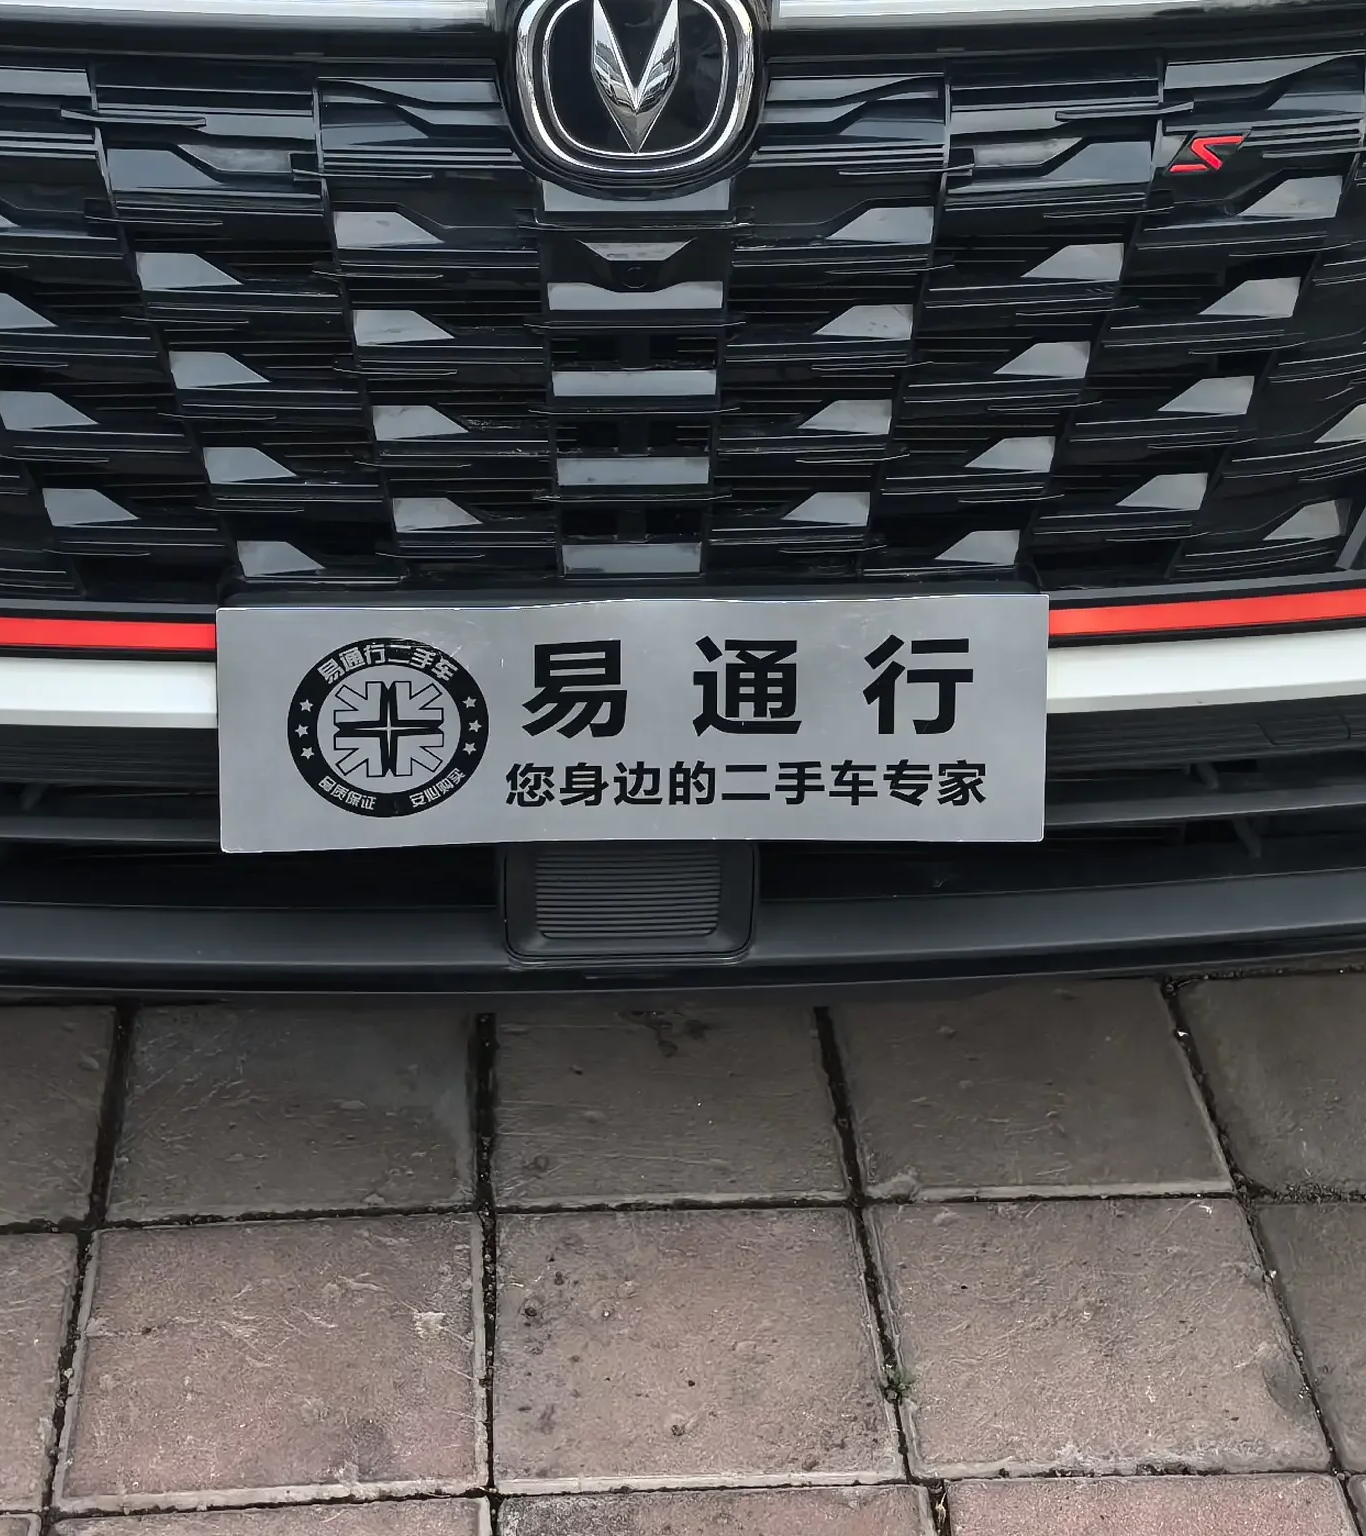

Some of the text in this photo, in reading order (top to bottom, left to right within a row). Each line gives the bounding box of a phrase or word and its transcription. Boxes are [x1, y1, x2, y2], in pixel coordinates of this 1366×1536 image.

[317, 643, 459, 685] 易通行二手车
[522, 634, 974, 739] 易通行
[318, 775, 378, 811] 品质保证
[409, 767, 466, 808] 安心购买
[505, 758, 987, 808] 您身边的二手车专家
